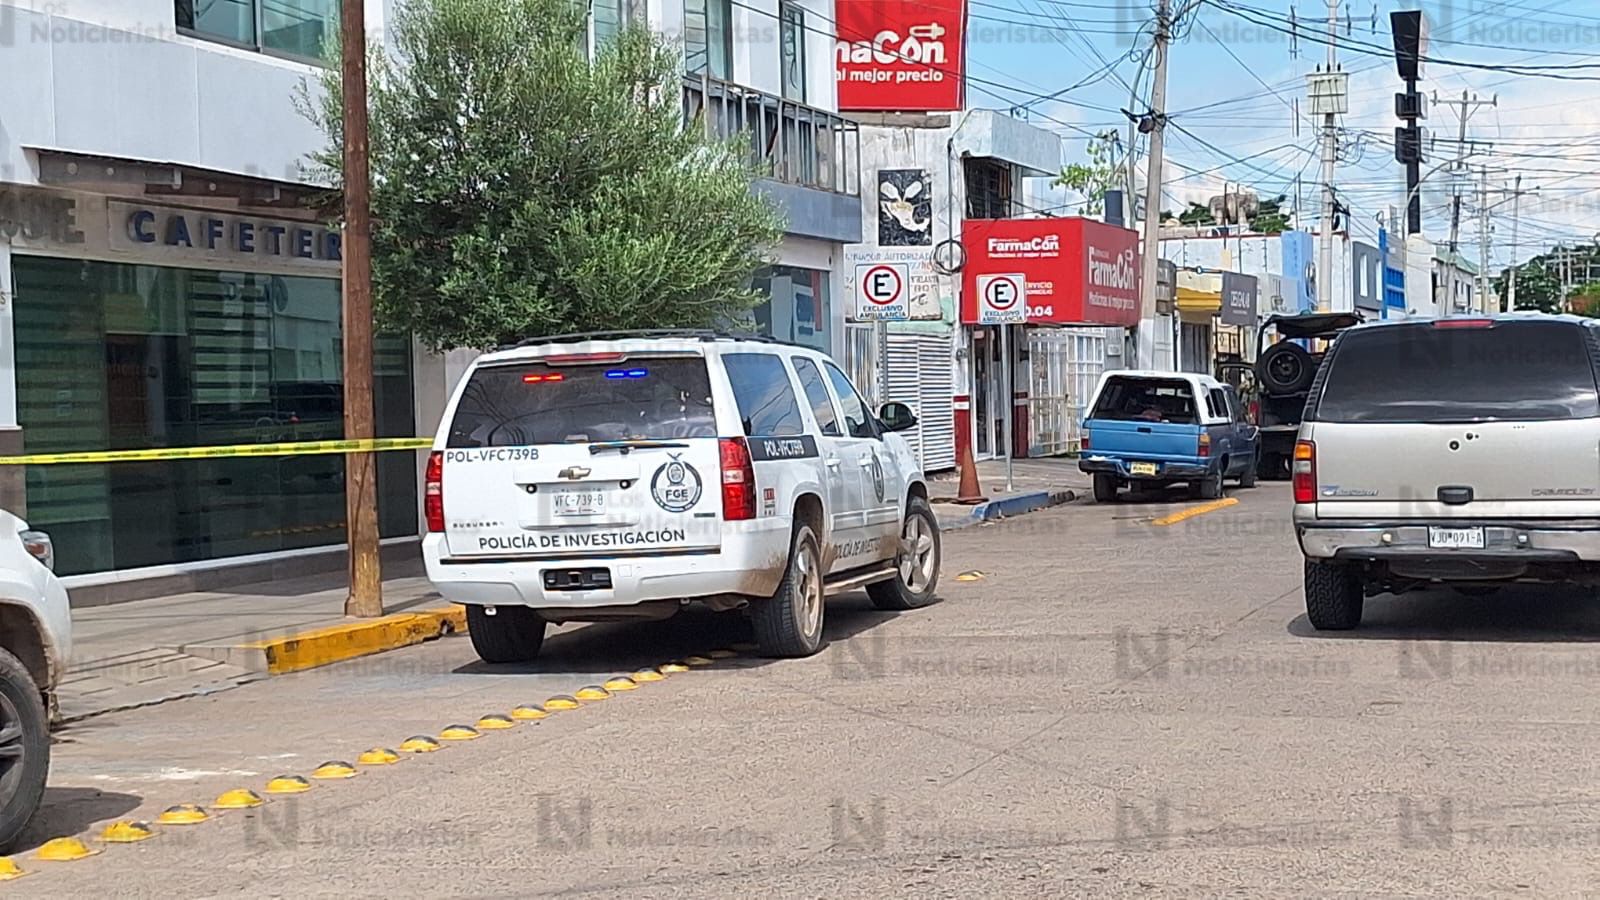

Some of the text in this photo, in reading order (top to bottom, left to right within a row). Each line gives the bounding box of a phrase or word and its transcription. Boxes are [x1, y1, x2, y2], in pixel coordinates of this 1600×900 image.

[850, 68, 893, 83] mejor
[896, 68, 943, 84] precio
[874, 274, 891, 296] E
[994, 284, 1010, 303] E
[447, 449, 539, 463] POL-VFC739B
[665, 489, 689, 499] FGE
[479, 528, 685, 549] POLICÍA DE INVESTIGACIÓN
